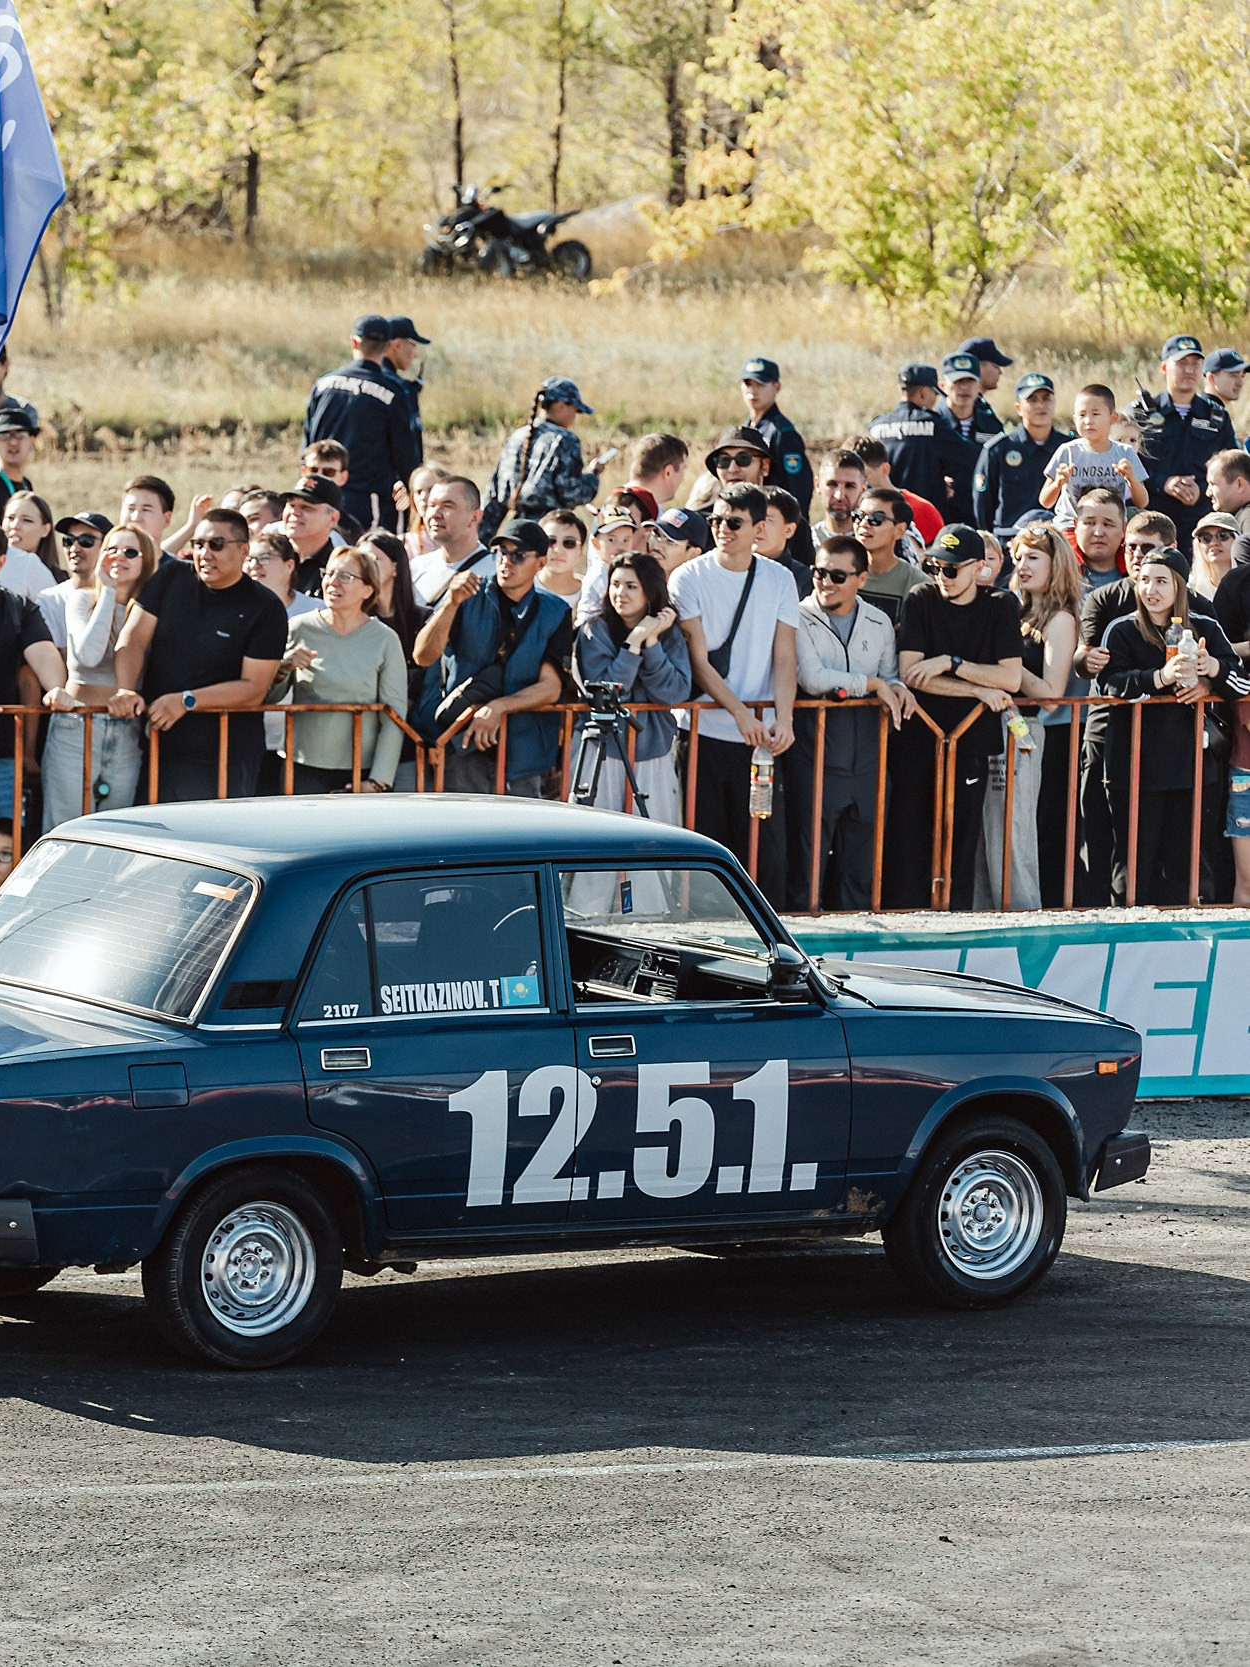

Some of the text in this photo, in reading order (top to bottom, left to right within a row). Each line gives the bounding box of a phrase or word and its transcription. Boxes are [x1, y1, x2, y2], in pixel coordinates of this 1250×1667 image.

[1071, 466, 1122, 477] DINOSAU
[381, 979, 500, 1015] SEITKAZINOV. T
[323, 1004, 359, 1018] 2107
[449, 1059, 819, 1207] 12.5.1.
